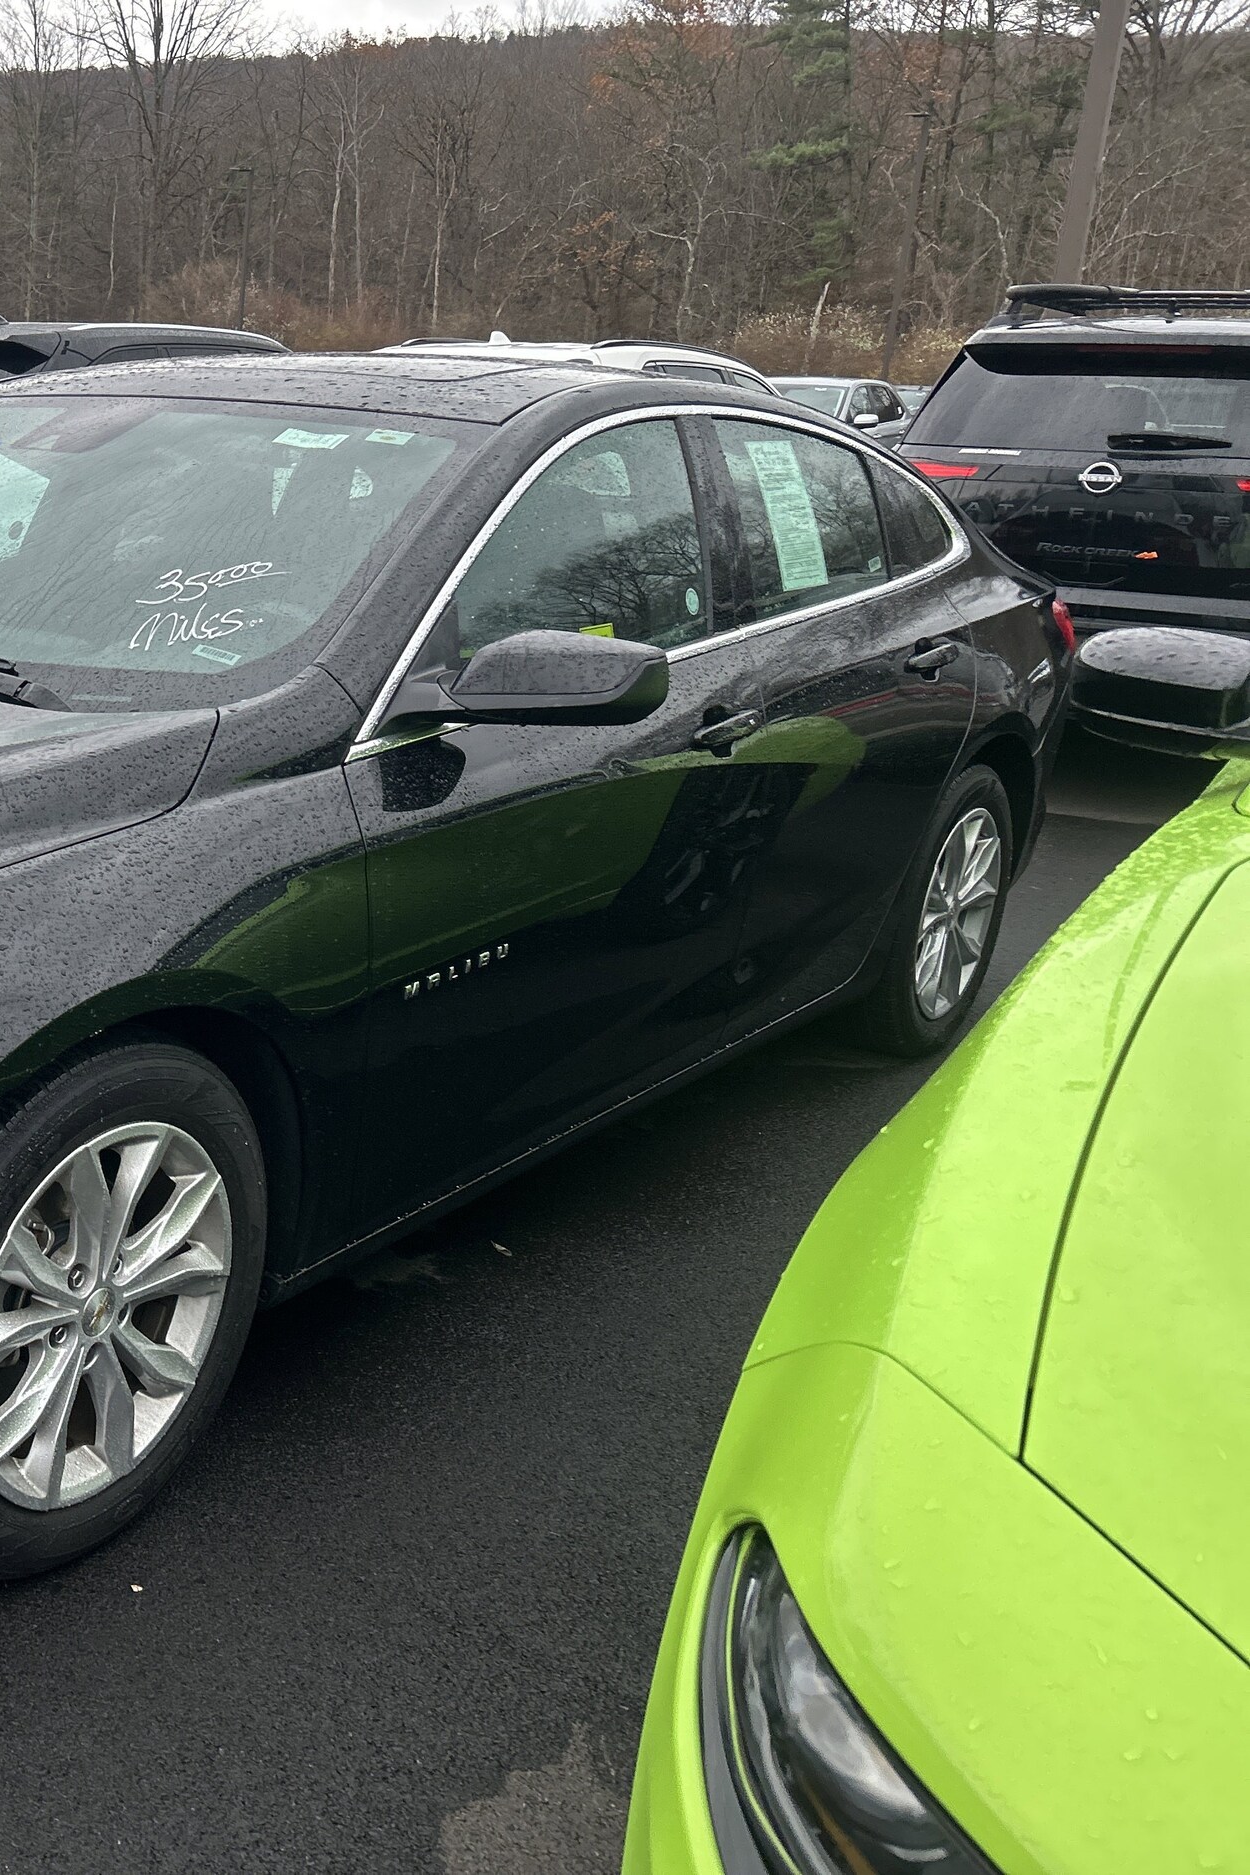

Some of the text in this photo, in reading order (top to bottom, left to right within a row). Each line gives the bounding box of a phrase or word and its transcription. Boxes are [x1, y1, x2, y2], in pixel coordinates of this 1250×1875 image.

[1078, 474, 1123, 483] NISSAN
[965, 501, 1232, 528] ATHFINDE
[404, 943, 509, 1000] MALIBU
